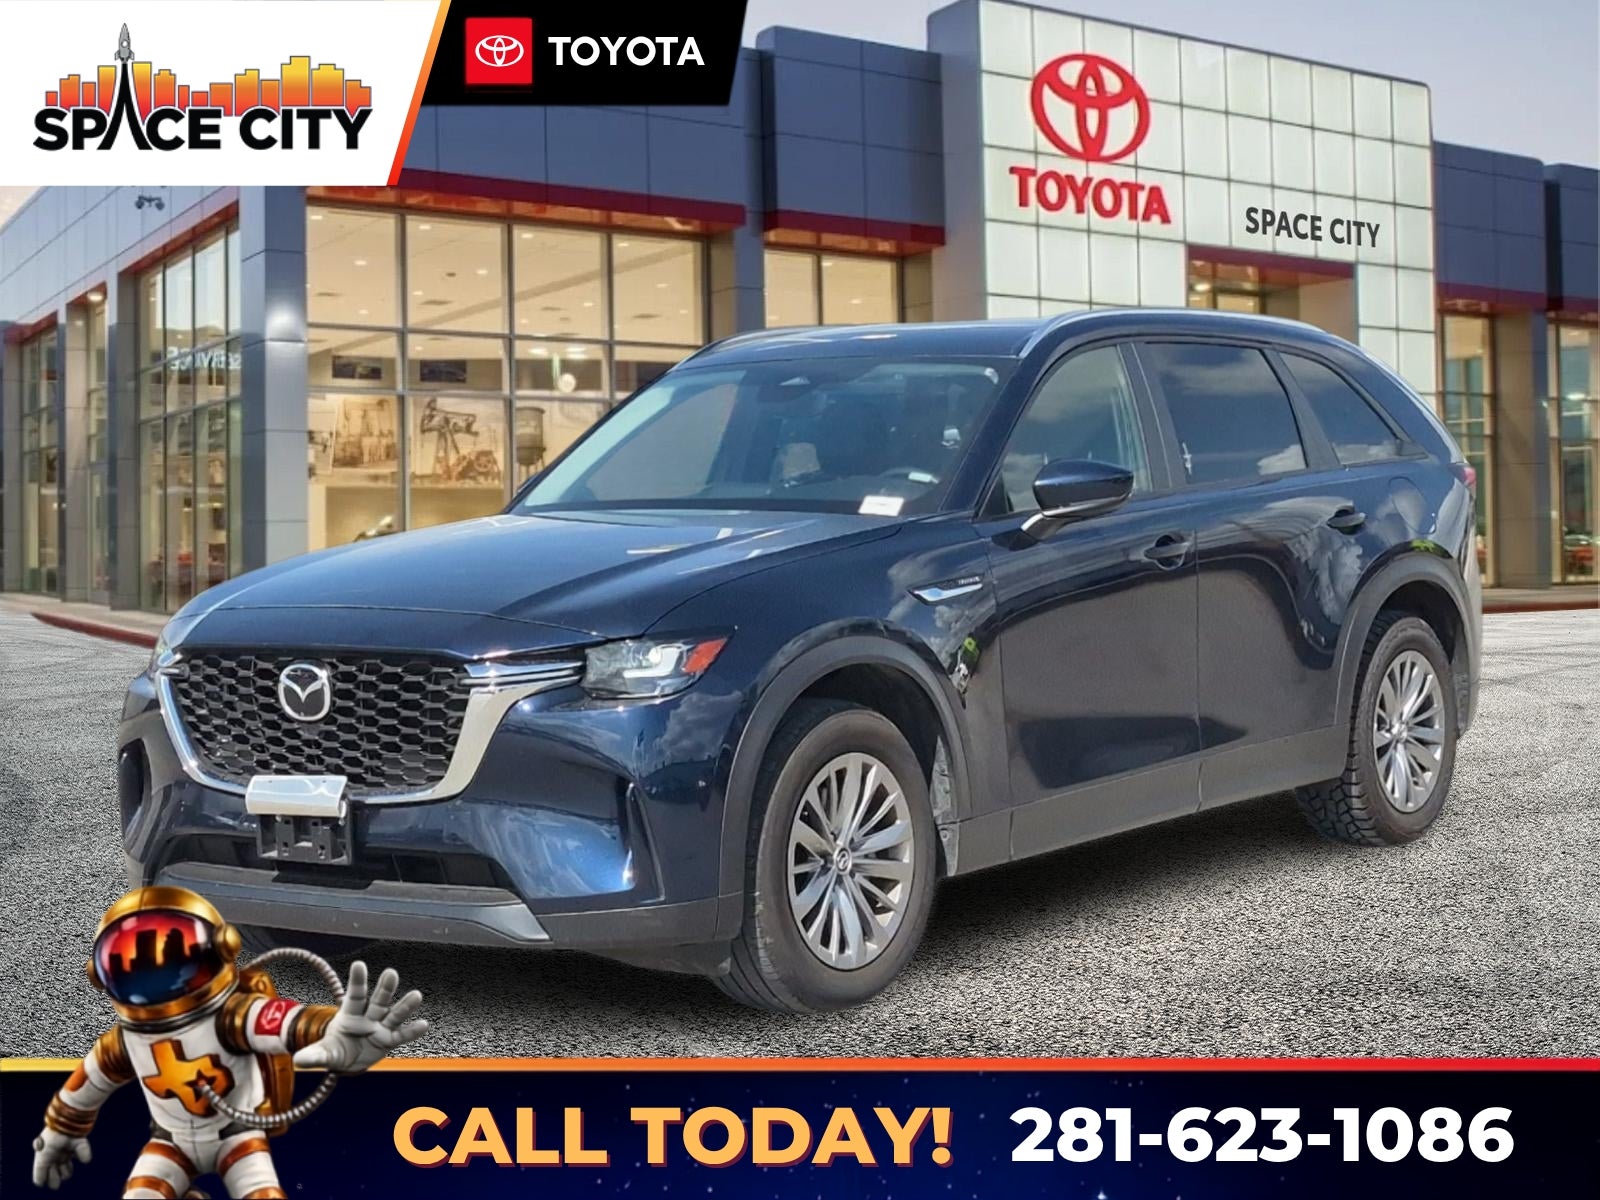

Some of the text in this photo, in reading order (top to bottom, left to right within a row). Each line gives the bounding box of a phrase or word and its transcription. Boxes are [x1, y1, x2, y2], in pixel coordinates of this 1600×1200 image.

[1009, 166, 1170, 224] TOYOTA
[1245, 207, 1380, 248] SPACE CITY
